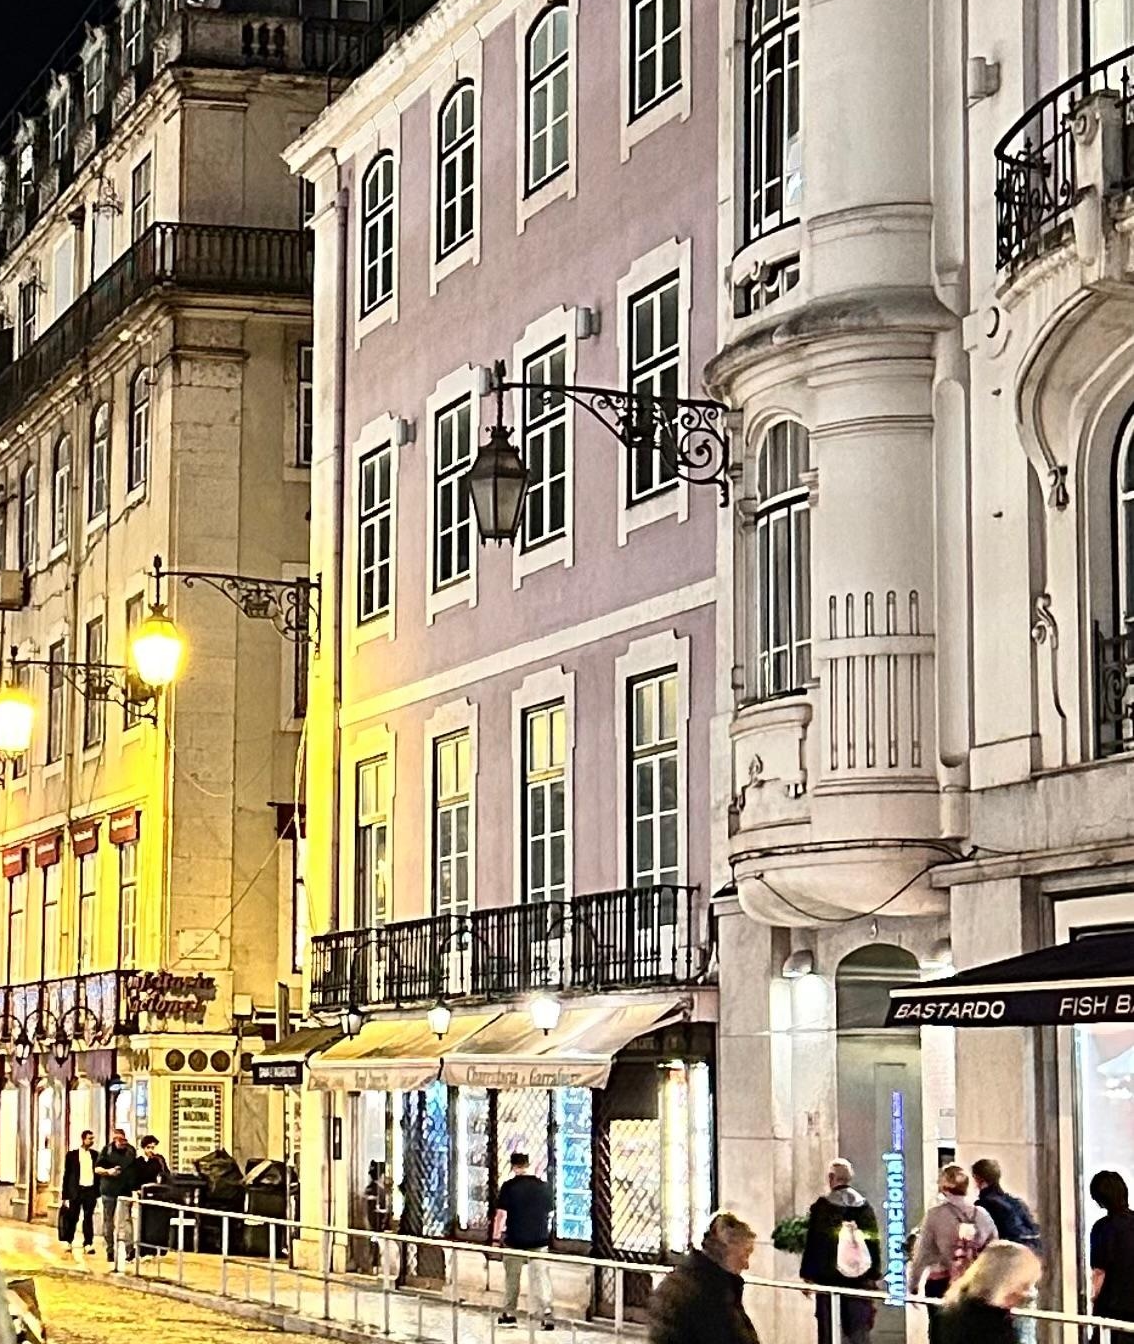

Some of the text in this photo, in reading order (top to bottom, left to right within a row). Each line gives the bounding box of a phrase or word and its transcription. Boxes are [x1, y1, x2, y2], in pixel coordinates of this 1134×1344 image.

[894, 993, 1134, 1020] BASTARDO FISH B
[882, 1152, 905, 1307] internacional
